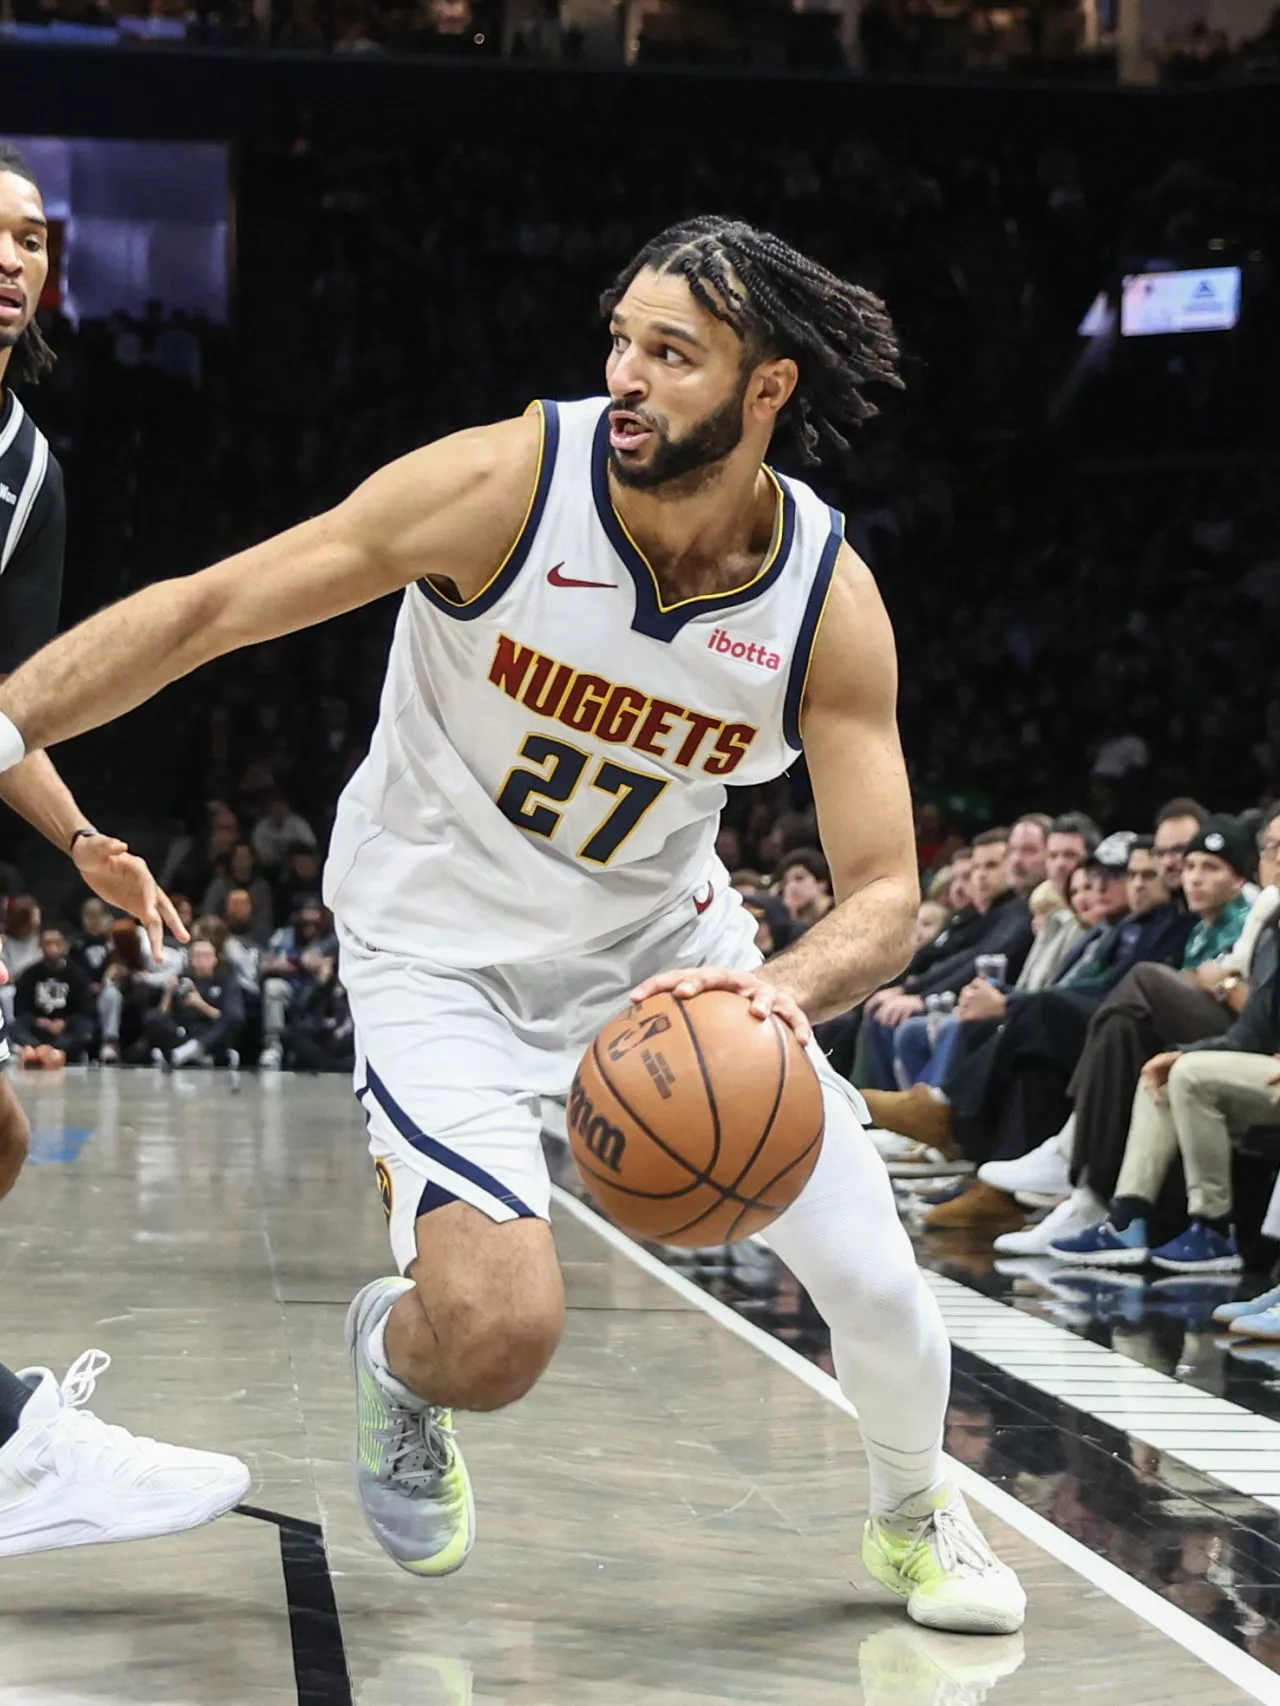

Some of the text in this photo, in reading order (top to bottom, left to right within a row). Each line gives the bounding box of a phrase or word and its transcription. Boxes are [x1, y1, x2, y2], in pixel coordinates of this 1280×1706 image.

[488, 632, 759, 775] NUGGETS
[707, 628, 781, 671] ibotta
[496, 732, 672, 866] 27
